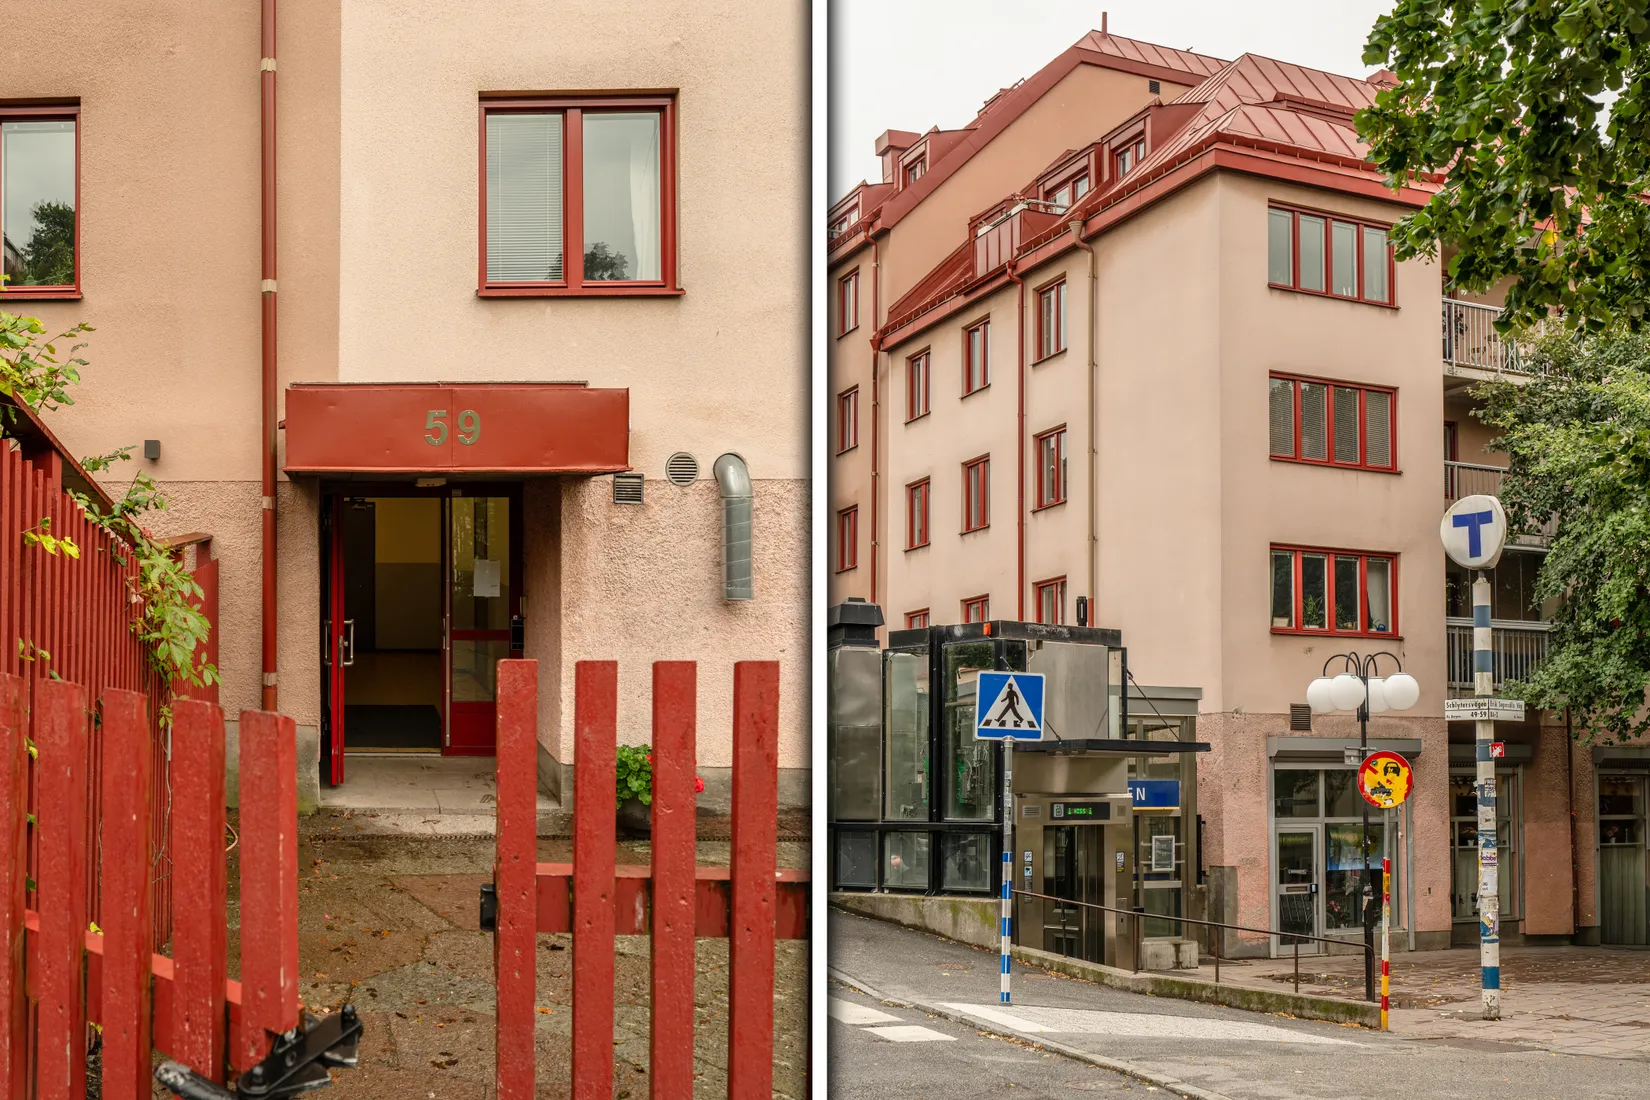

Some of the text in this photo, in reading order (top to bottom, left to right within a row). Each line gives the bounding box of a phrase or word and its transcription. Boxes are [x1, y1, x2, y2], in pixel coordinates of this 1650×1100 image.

[424, 409, 481, 446] 59
[1452, 510, 1493, 558] T
[1446, 701, 1487, 710] Schlytersvägen
